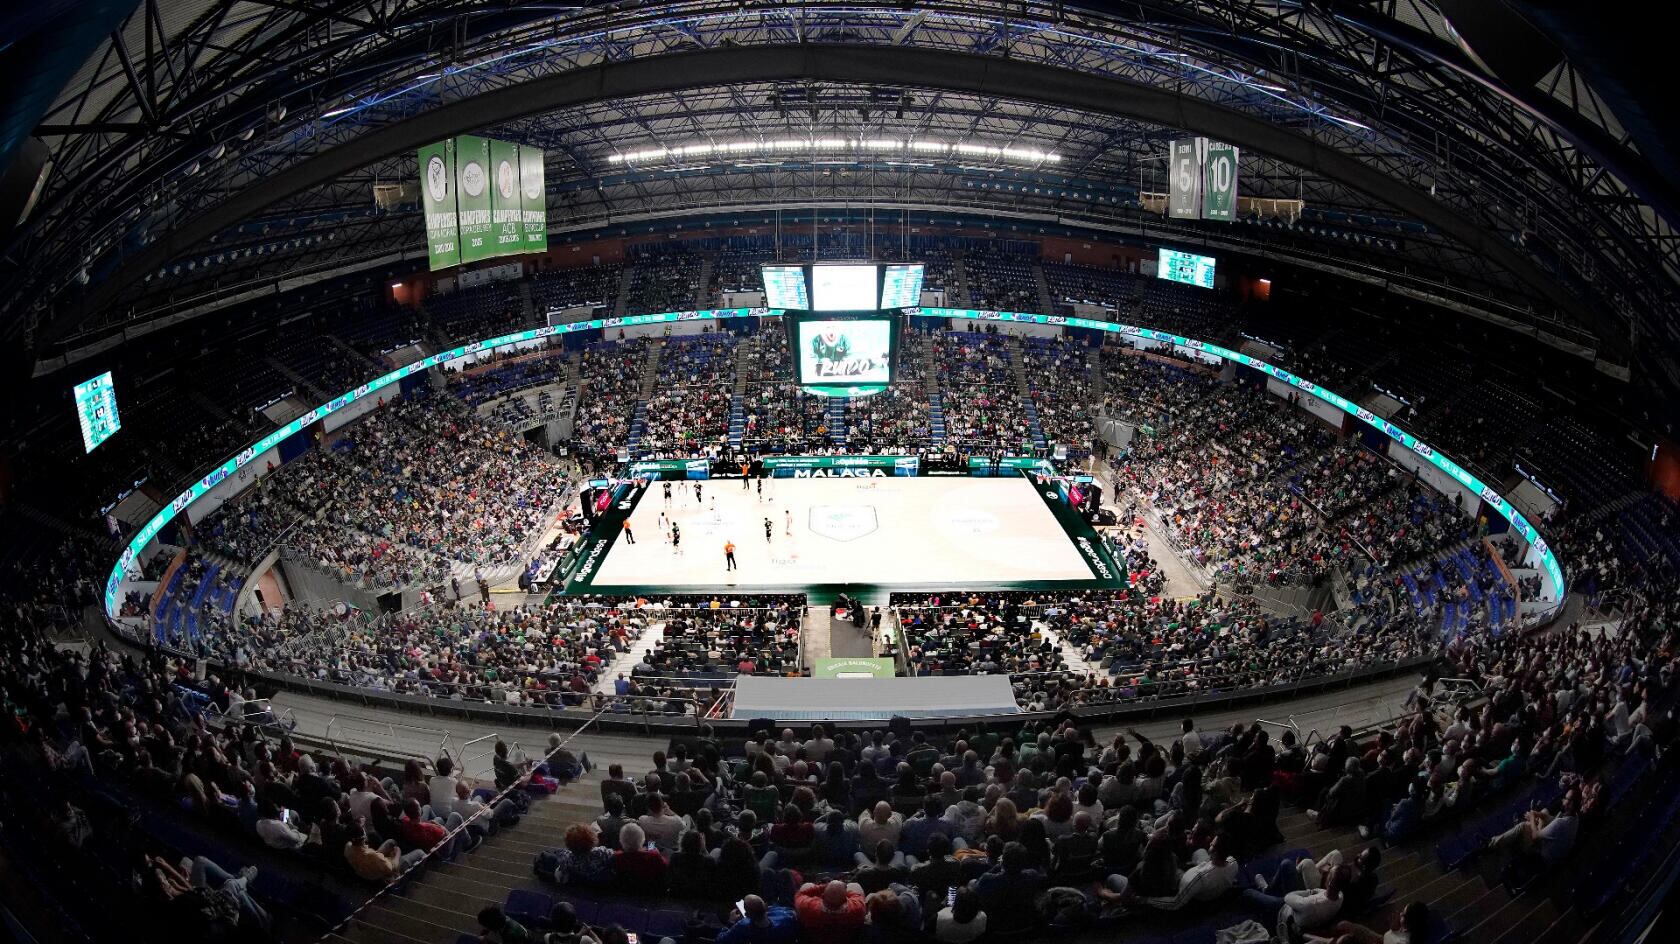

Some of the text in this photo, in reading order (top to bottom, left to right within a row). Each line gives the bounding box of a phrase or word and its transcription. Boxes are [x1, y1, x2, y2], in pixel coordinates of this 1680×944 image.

[1180, 158, 1191, 192] 5
[1211, 156, 1230, 193] 10
[502, 222, 517, 234] ACB
[794, 467, 886, 478] MÁLAGA
